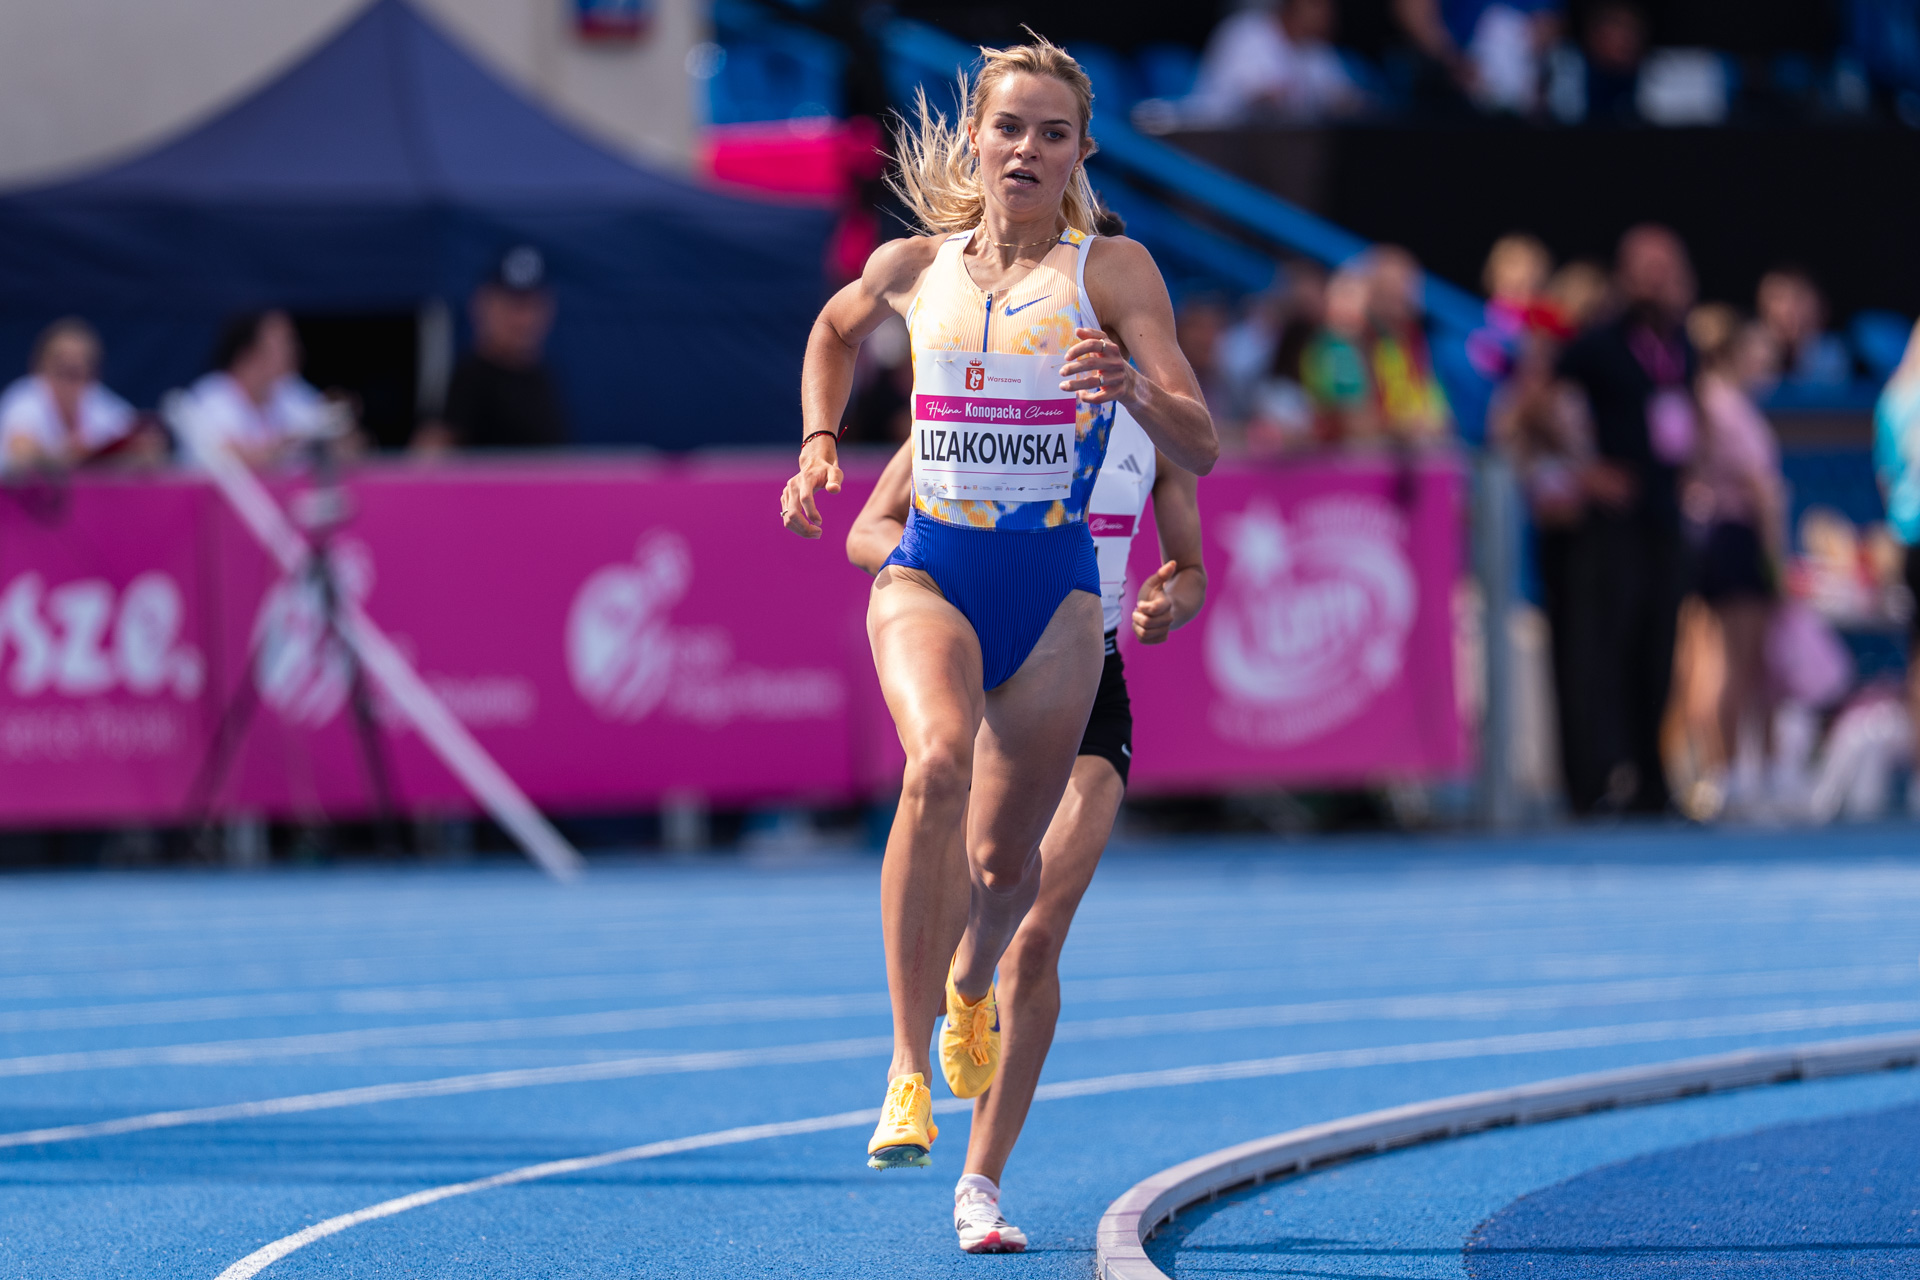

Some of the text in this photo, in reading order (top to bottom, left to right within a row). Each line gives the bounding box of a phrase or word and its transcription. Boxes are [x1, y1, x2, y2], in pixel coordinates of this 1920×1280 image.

[987, 375, 1022, 384] Warszawa
[925, 401, 1064, 421] Halina Konopacka Classic
[921, 429, 1068, 465] LIZAKOWSKA
